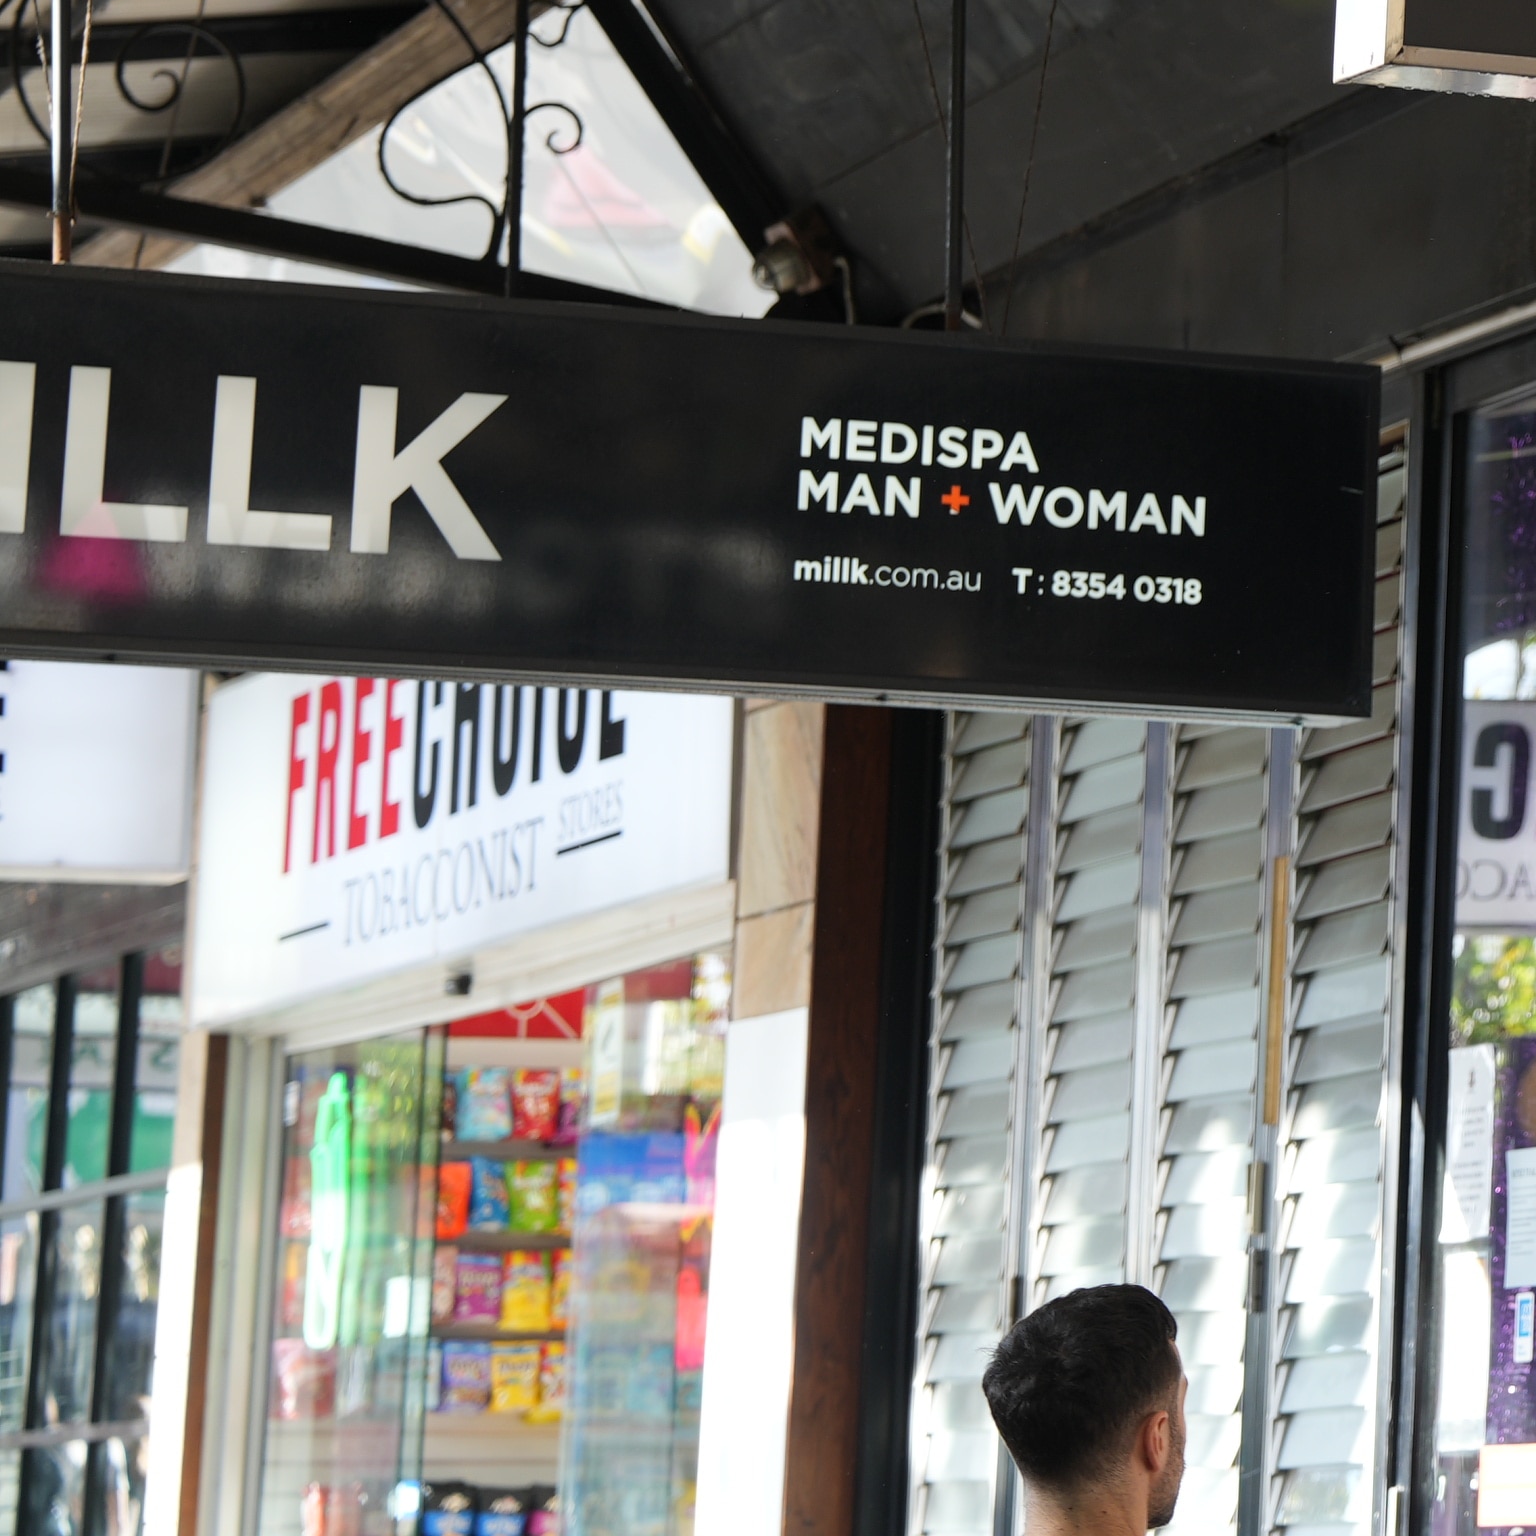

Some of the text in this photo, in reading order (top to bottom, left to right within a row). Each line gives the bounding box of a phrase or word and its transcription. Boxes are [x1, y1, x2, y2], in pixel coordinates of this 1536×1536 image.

[800, 416, 1040, 474] MEDISPA
[797, 469, 922, 519] MAN
[988, 481, 1207, 537] WOMAN
[793, 555, 982, 592] millk.com.au
[1051, 569, 1127, 600] 8354
[1133, 575, 1203, 605] 0318
[557, 780, 625, 842] STORES
[344, 816, 545, 947] TOBACCONIST
